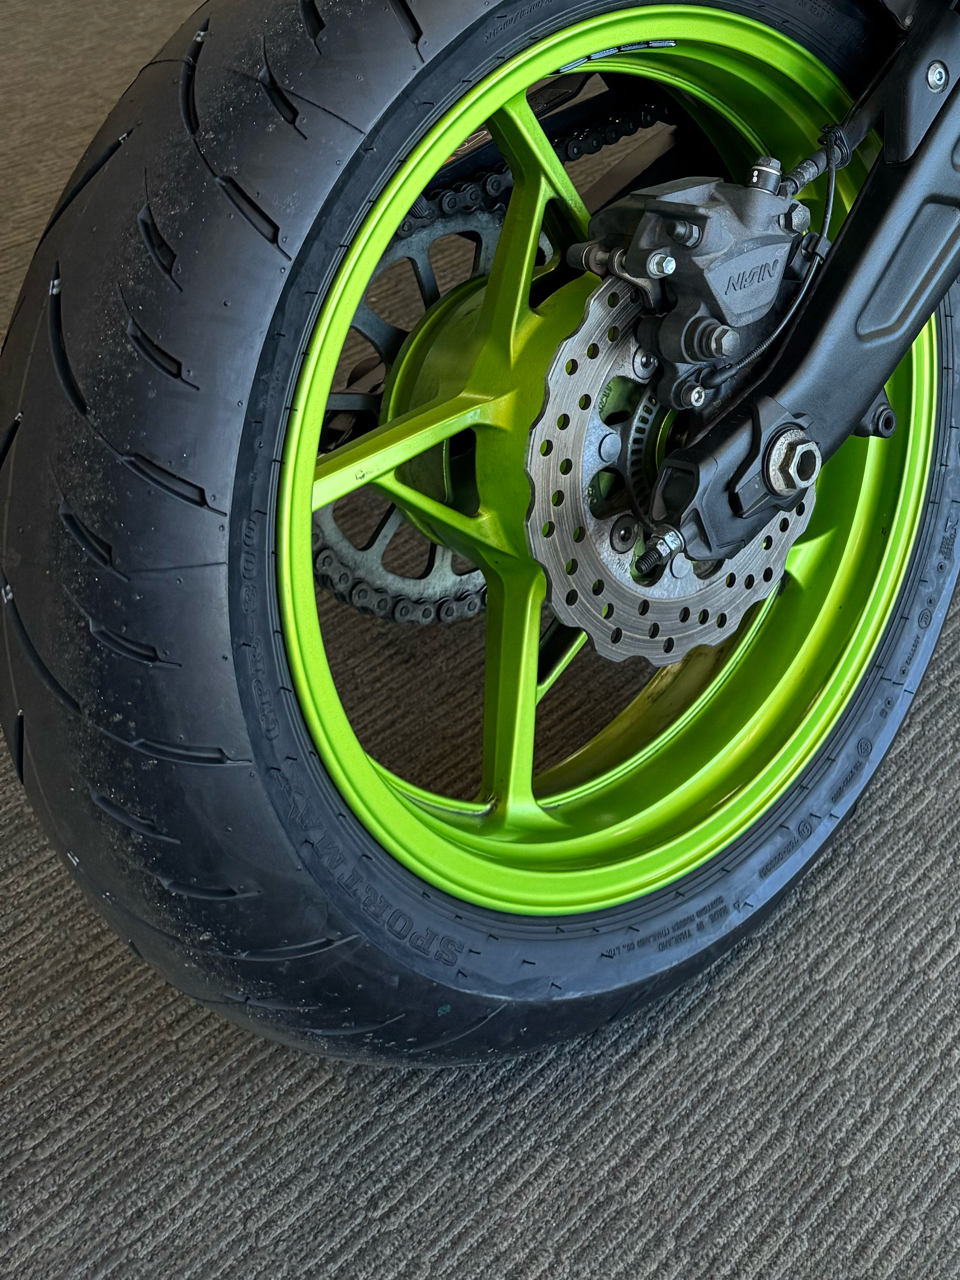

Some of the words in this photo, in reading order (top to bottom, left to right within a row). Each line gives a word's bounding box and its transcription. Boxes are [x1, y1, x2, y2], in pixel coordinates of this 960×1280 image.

[240, 518, 280, 743] GPR-300
[271, 760, 464, 968] SPORTMAX
[710, 904, 730, 925] MADE
[658, 929, 693, 952] THAILAND
